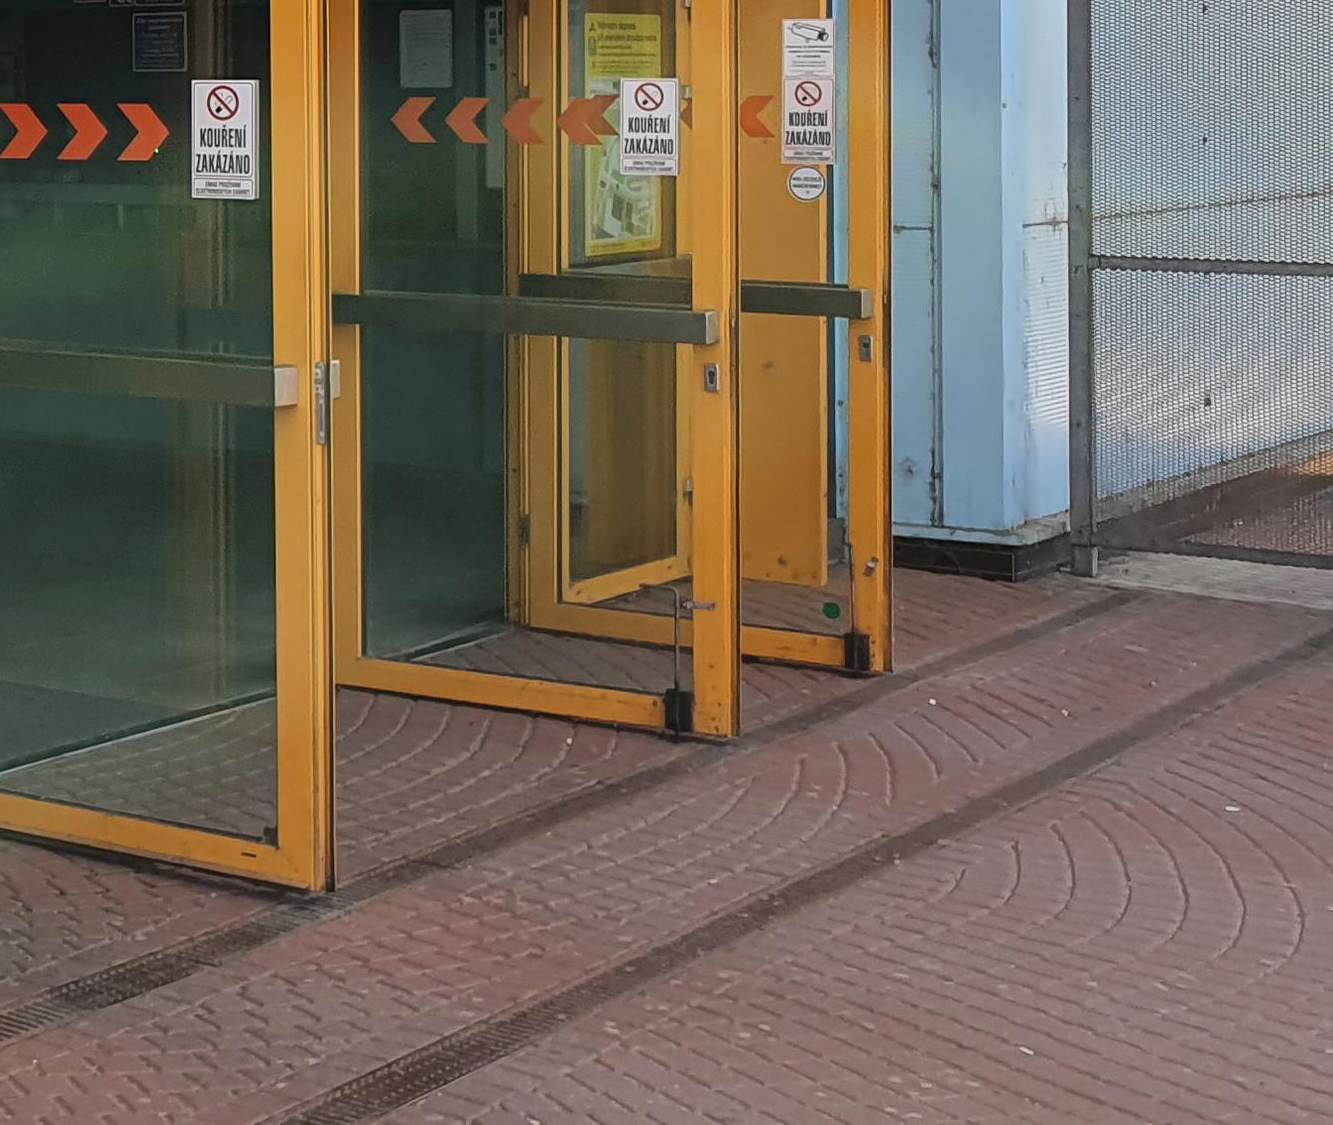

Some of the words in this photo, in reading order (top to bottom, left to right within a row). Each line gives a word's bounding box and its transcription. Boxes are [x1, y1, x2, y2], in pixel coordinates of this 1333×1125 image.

[628, 114, 671, 134] KOUŘENÍ
[788, 109, 828, 127] KOUŘENÍ
[199, 124, 247, 148] KOUŘENÍ
[624, 135, 674, 155] ZAKÁZÁNO
[785, 128, 831, 146] ZAKÁZÁNO
[196, 150, 250, 174] ZAKÁZÁNO
